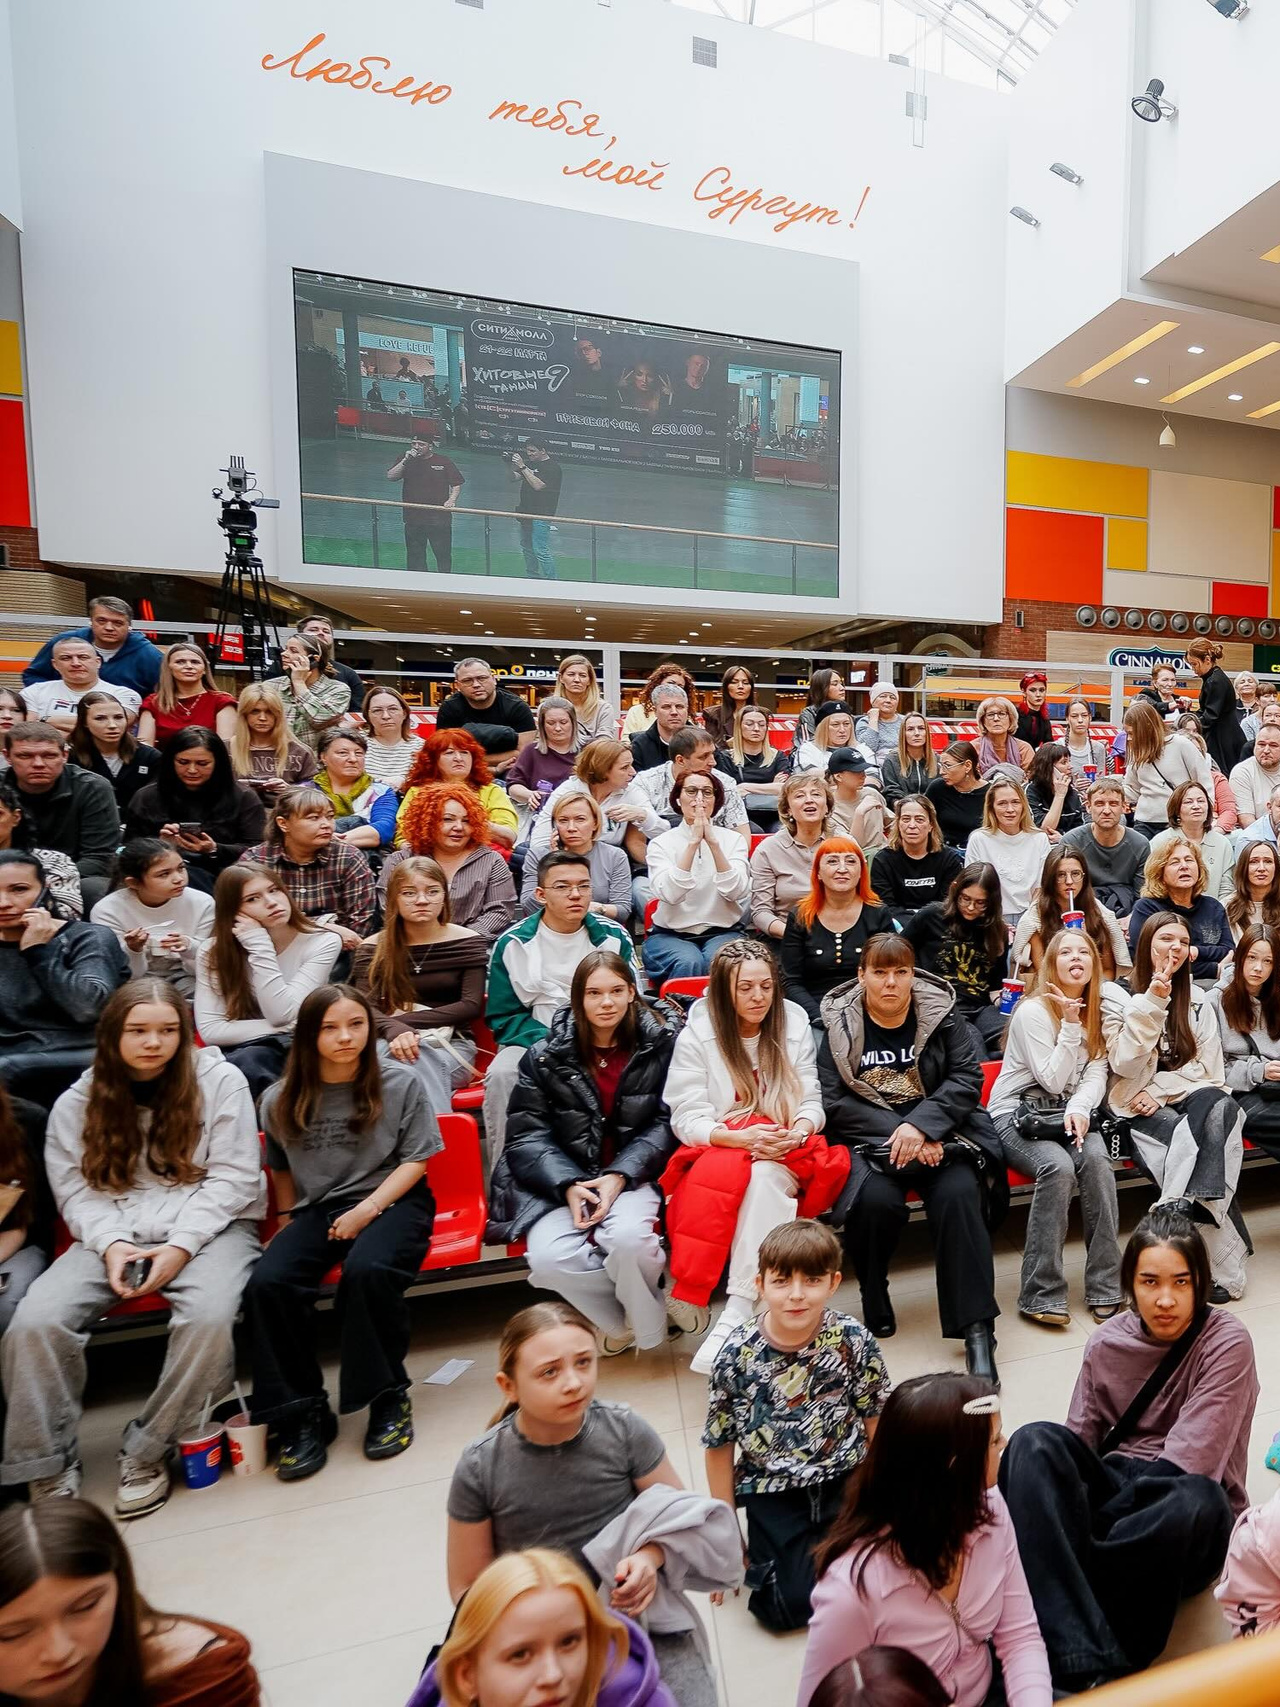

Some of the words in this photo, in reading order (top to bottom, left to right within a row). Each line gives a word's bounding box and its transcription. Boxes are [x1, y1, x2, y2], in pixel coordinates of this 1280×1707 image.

[261, 33, 452, 106] Люблю
[488, 99, 617, 150] тебя,
[563, 157, 671, 191] мой
[694, 166, 871, 233] Сургут!
[861, 1050, 897, 1067] WILD
